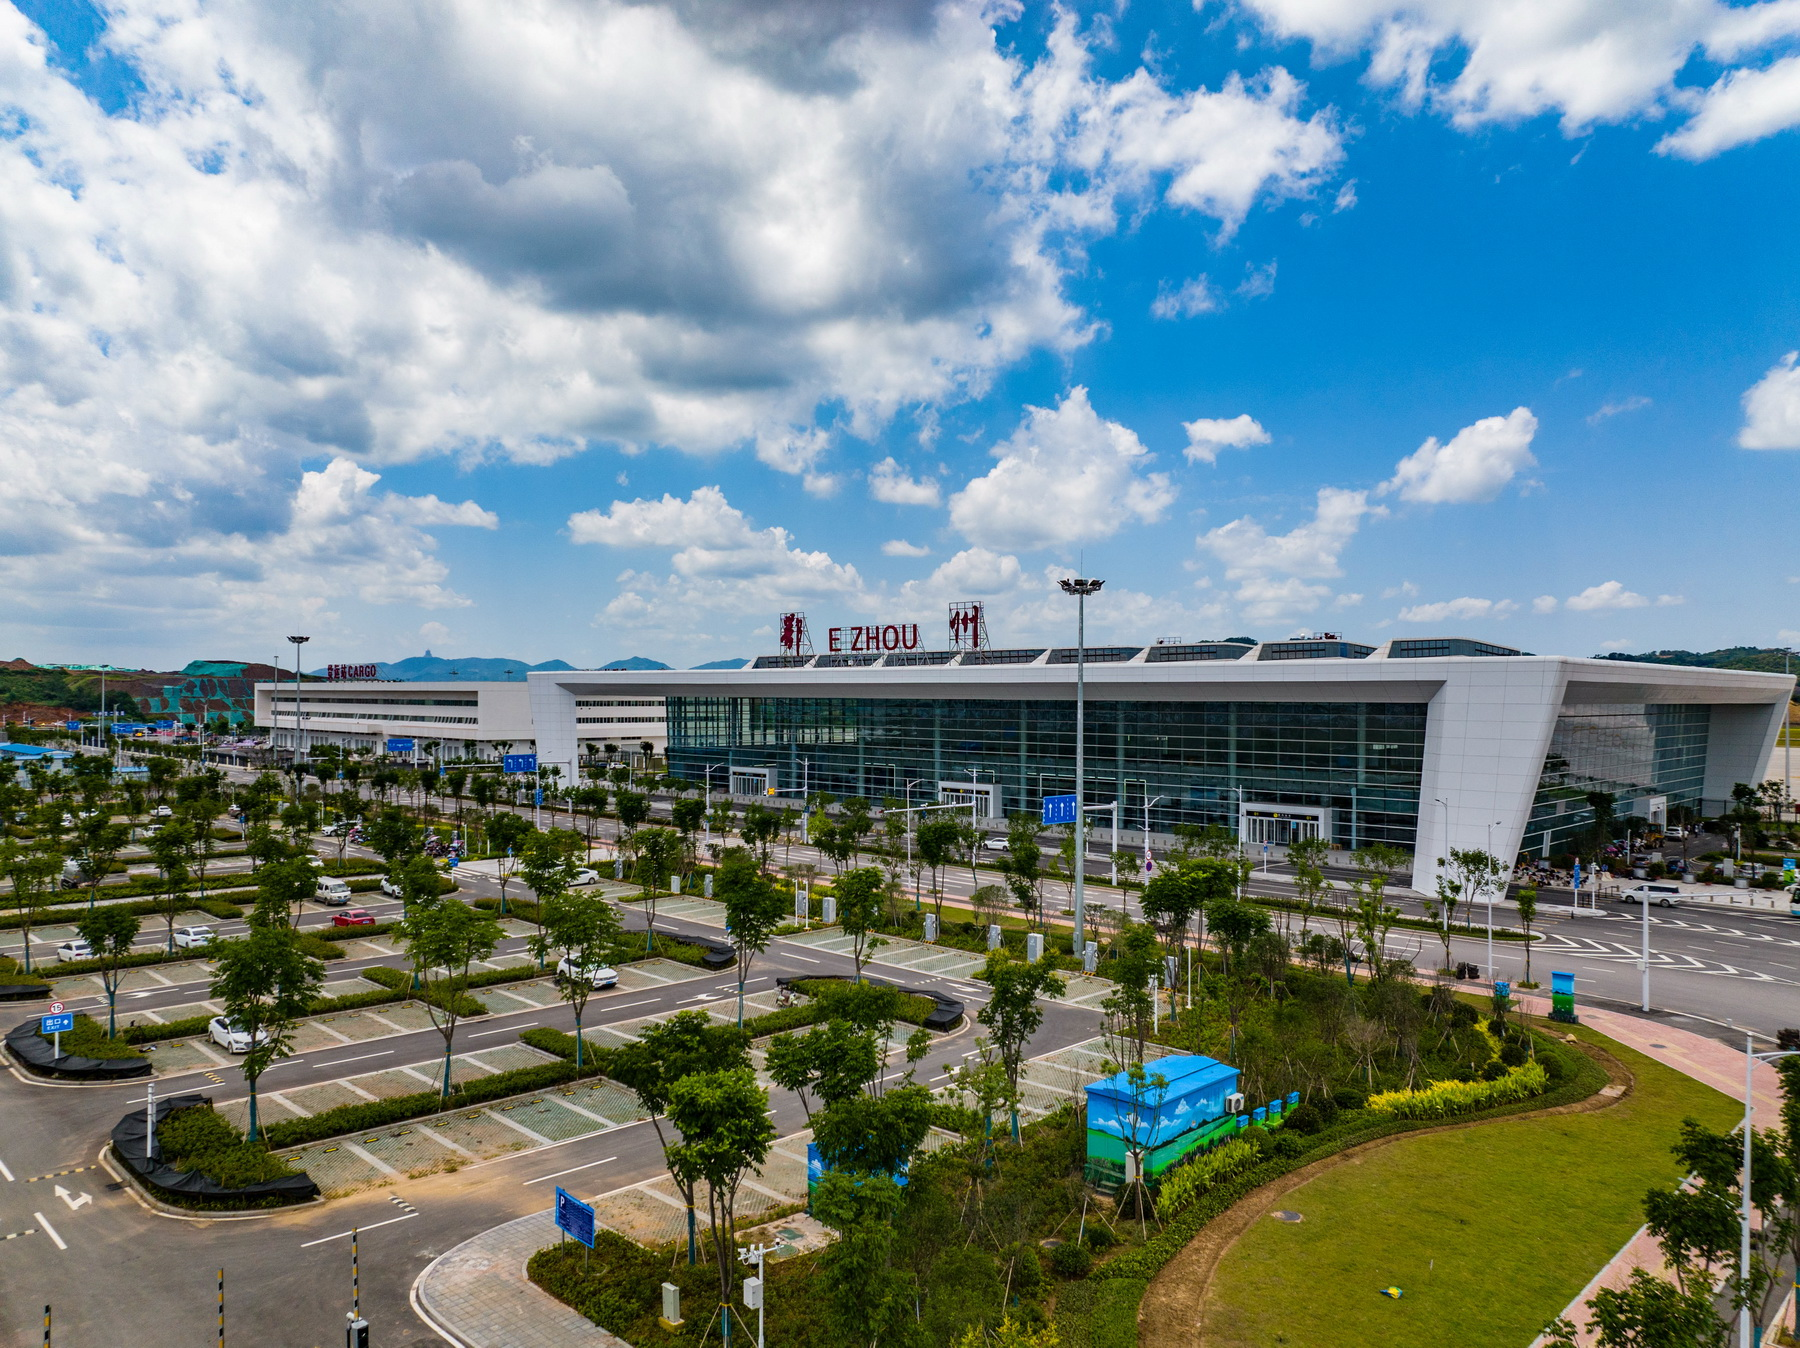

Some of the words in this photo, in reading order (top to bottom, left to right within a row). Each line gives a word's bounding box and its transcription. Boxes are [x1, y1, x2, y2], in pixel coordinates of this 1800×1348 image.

[949, 605, 979, 649] 州
[347, 664, 377, 678] CARGO
[52, 1004, 62, 1012] 15
[560, 1195, 566, 1208] P
